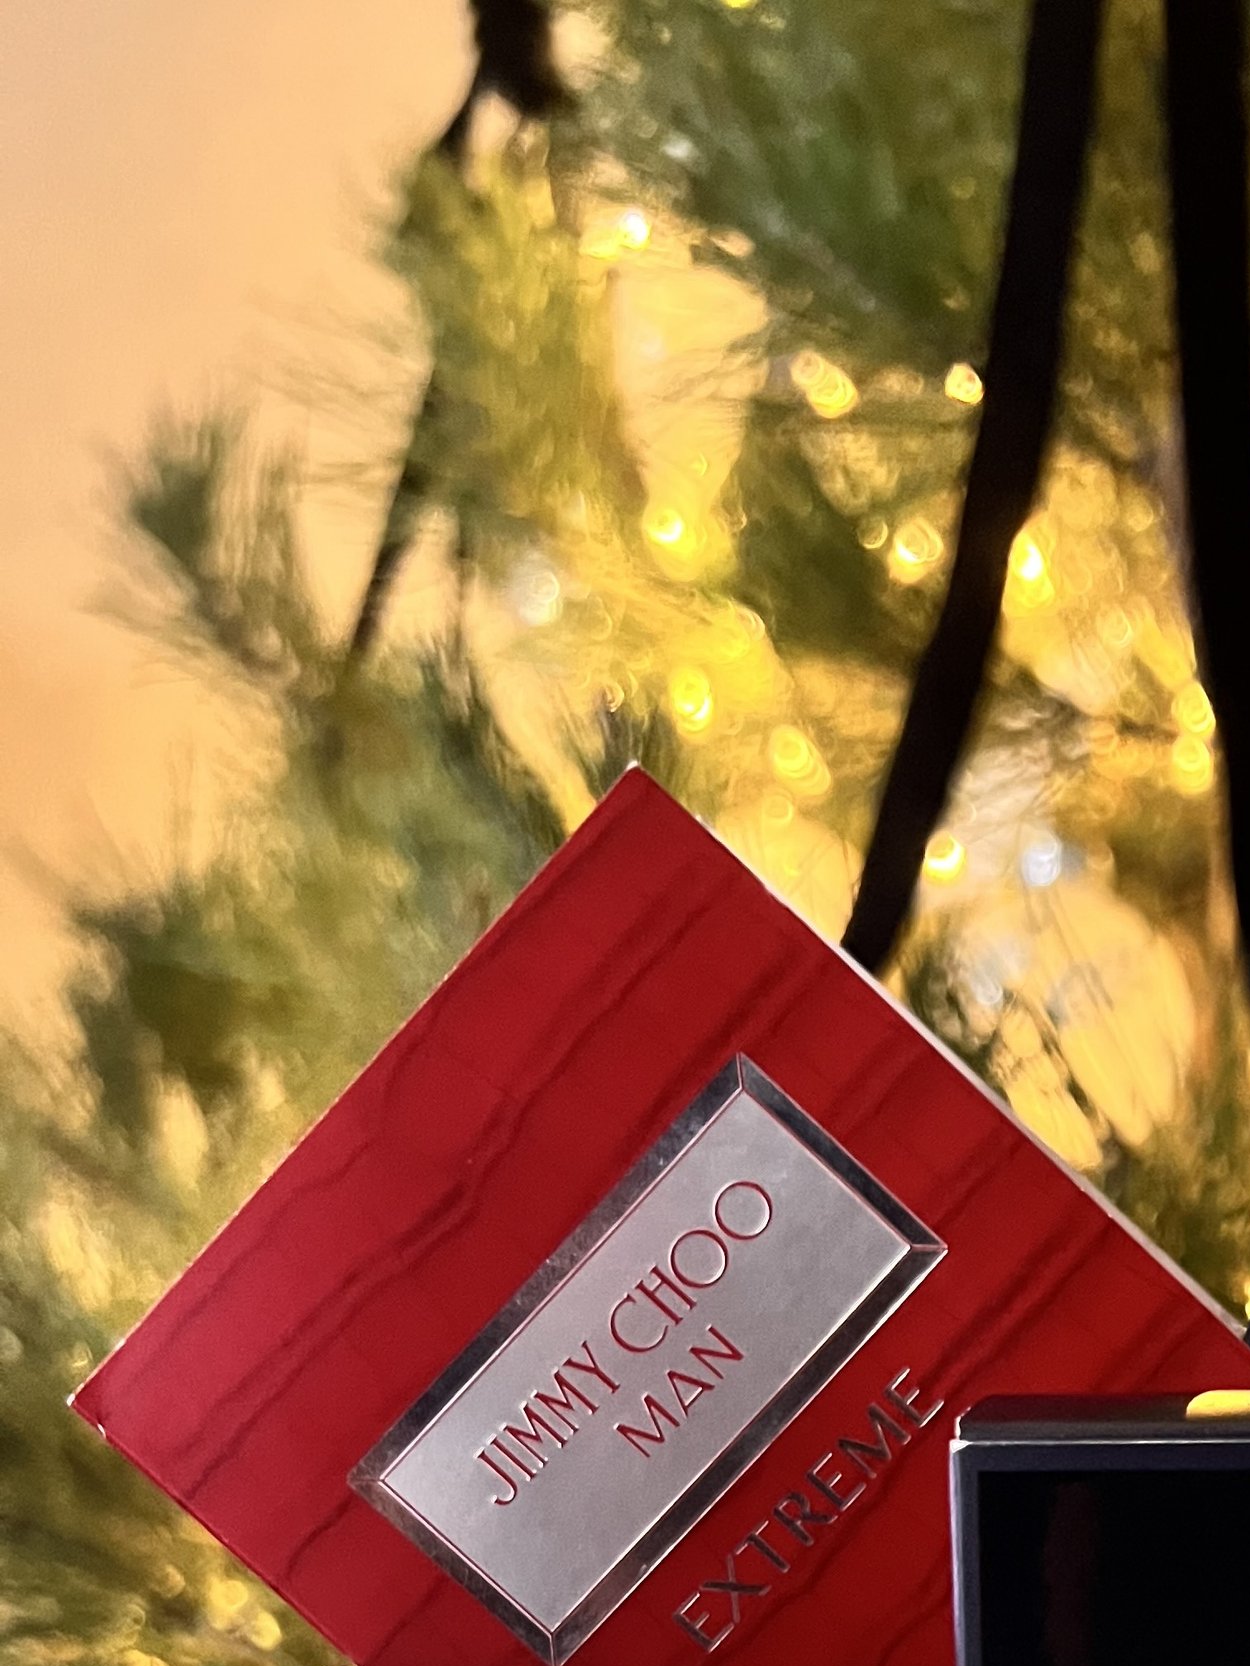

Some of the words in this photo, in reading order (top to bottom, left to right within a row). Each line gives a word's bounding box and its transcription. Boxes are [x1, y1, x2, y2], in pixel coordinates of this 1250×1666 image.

[475, 1341, 620, 1506] JIMMY
[609, 1181, 773, 1353] CHOO
[613, 1325, 745, 1459] MAN
[673, 1368, 945, 1652] EXTREME
